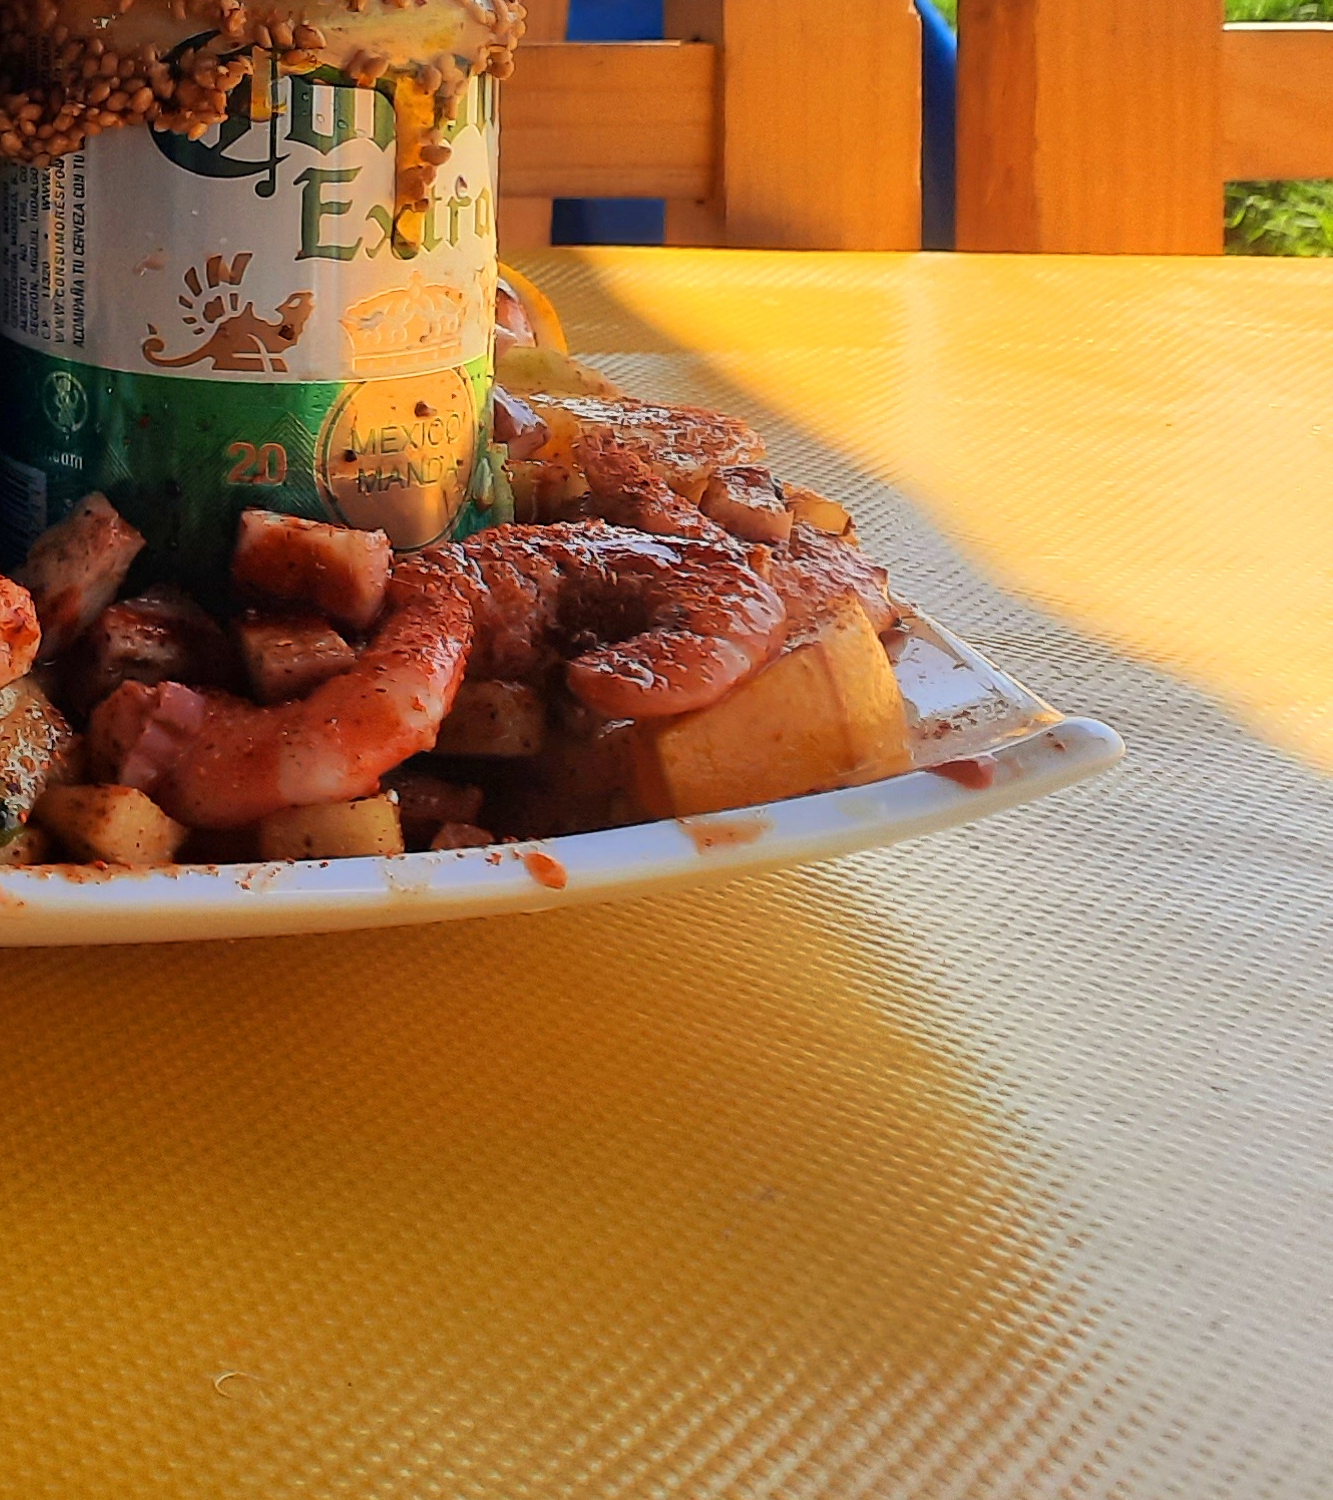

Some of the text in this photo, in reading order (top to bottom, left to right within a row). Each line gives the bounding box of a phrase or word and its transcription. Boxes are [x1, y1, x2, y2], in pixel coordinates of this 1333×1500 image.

[73, 154, 85, 169] TU
[72, 203, 85, 256] CERVEZA
[72, 259, 85, 274] TU
[70, 279, 85, 349] ACOMPAÑA
[227, 441, 288, 486] 20
